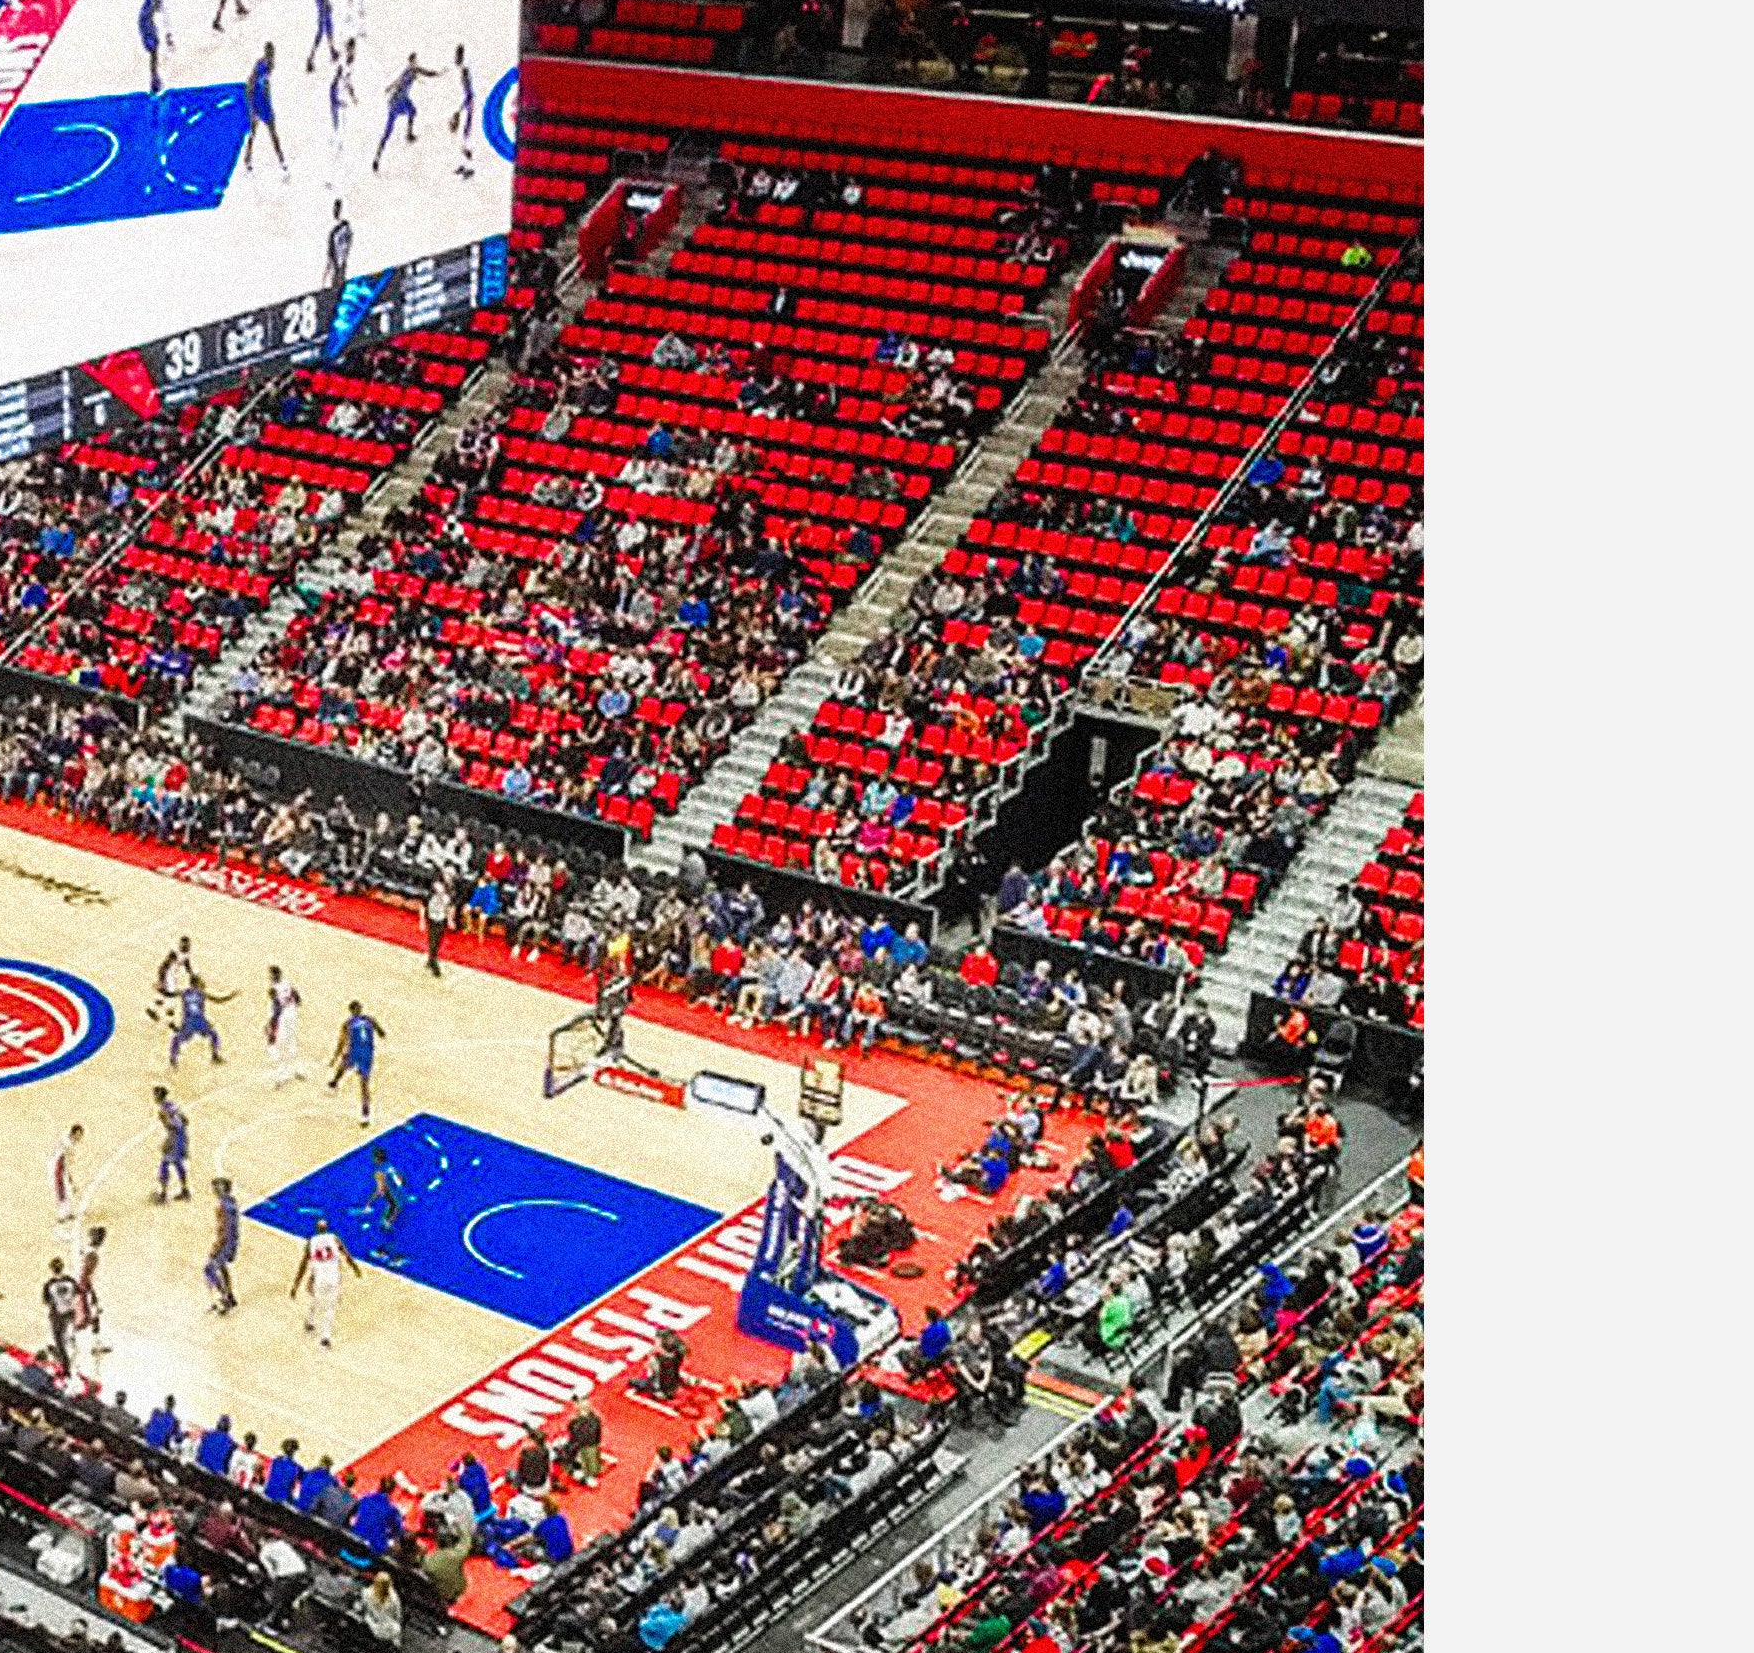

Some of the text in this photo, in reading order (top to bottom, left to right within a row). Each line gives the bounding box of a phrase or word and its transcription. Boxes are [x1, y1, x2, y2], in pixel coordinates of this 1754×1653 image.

[282, 297, 317, 344] 28
[165, 331, 201, 380] 39
[440, 1288, 711, 1449] PISTONS
